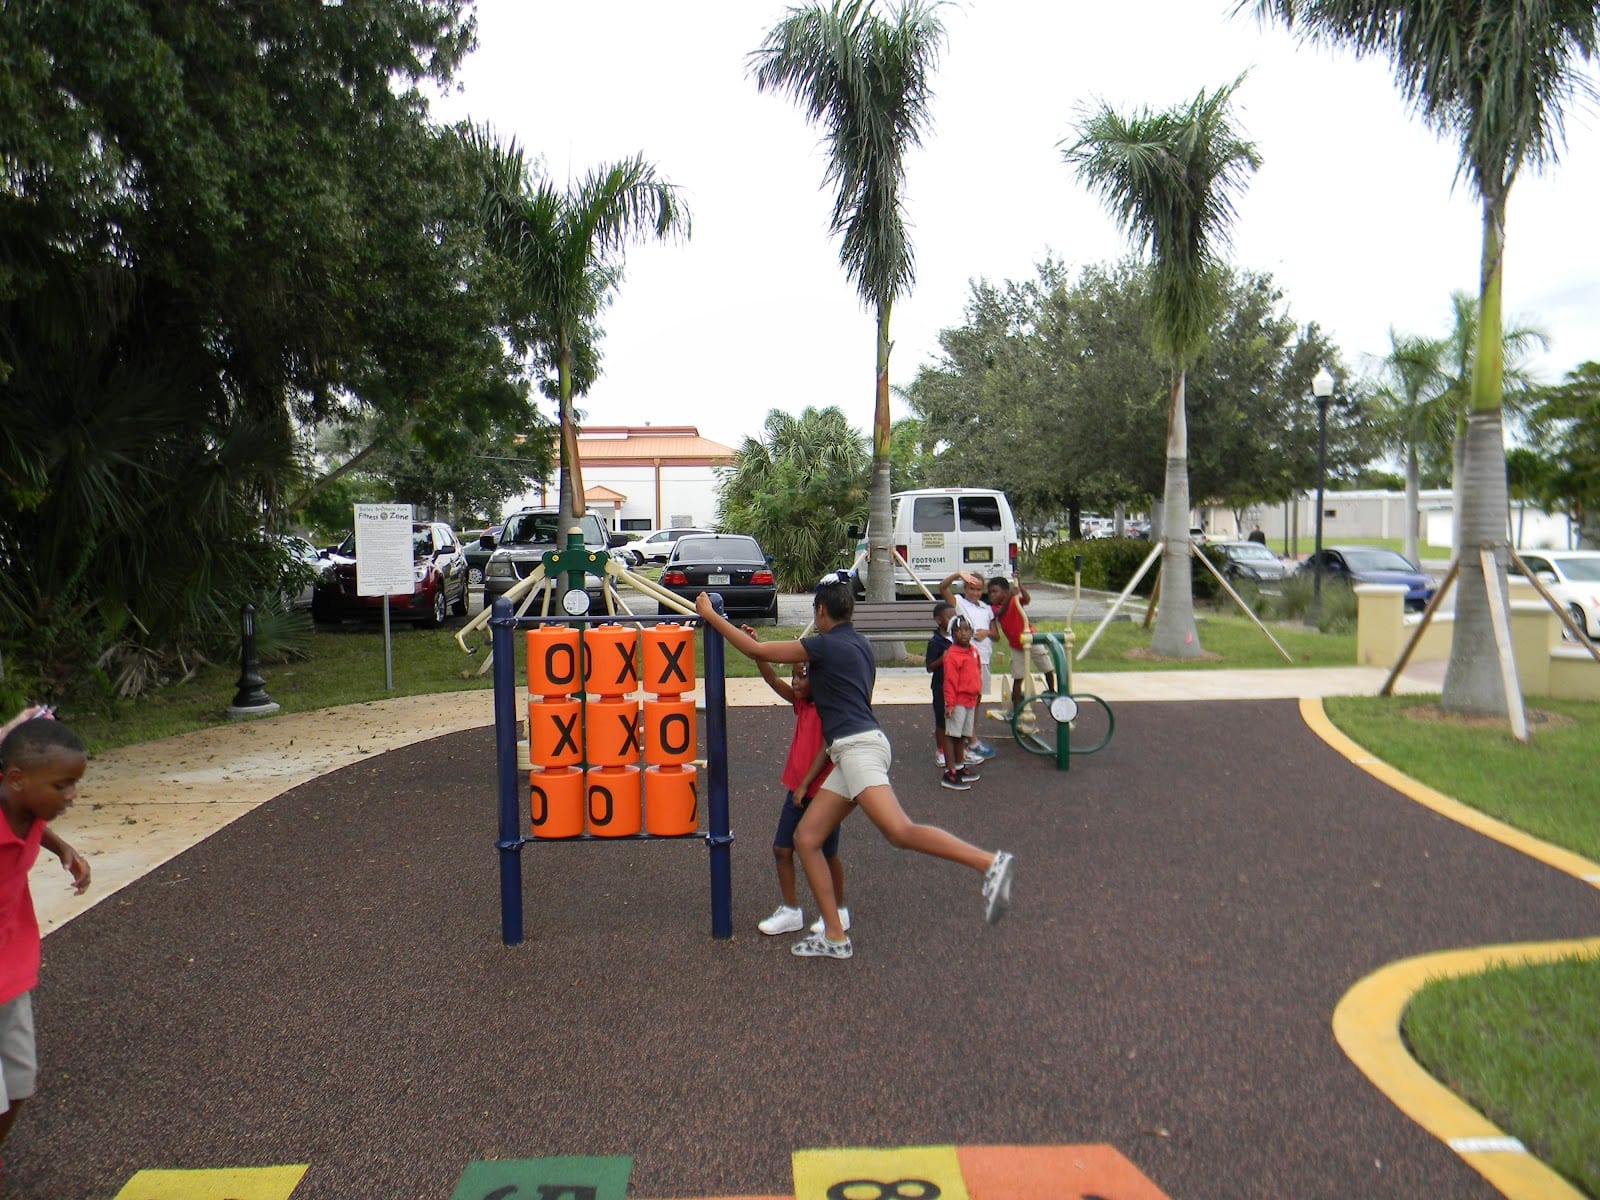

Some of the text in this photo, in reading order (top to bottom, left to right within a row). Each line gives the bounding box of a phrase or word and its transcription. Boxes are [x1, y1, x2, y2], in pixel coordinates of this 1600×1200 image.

[358, 512, 409, 521] Fitness Zone
[657, 641, 687, 684] X
[550, 713, 578, 757] X
